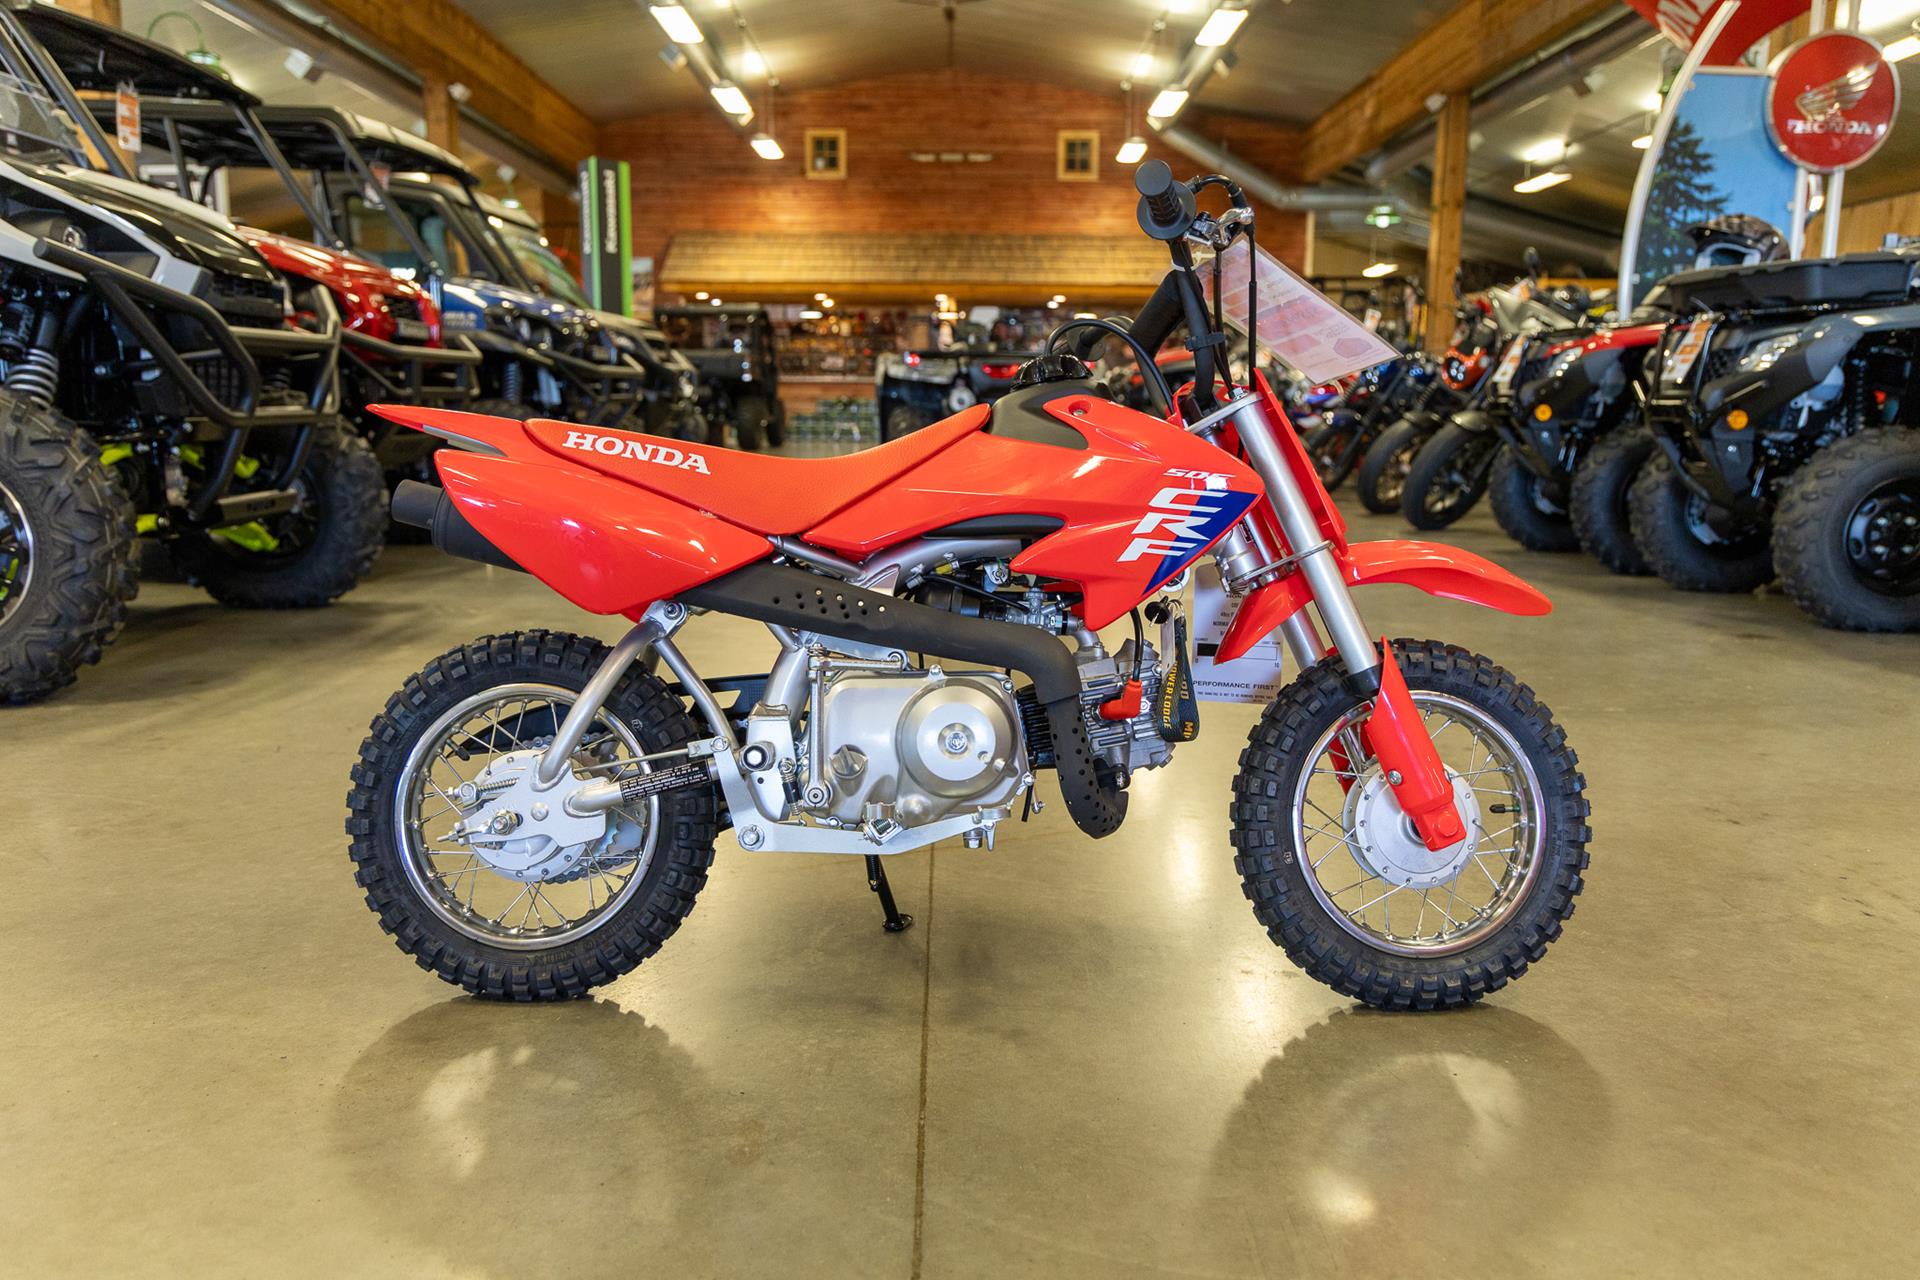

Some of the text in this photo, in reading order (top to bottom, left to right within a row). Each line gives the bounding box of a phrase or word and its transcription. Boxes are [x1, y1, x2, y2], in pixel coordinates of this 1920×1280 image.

[1788, 119, 1873, 135] HONDA
[562, 431, 711, 475] HONDA
[1117, 487, 1229, 562] CRF
[1193, 681, 1250, 690] PERFORMANCE
